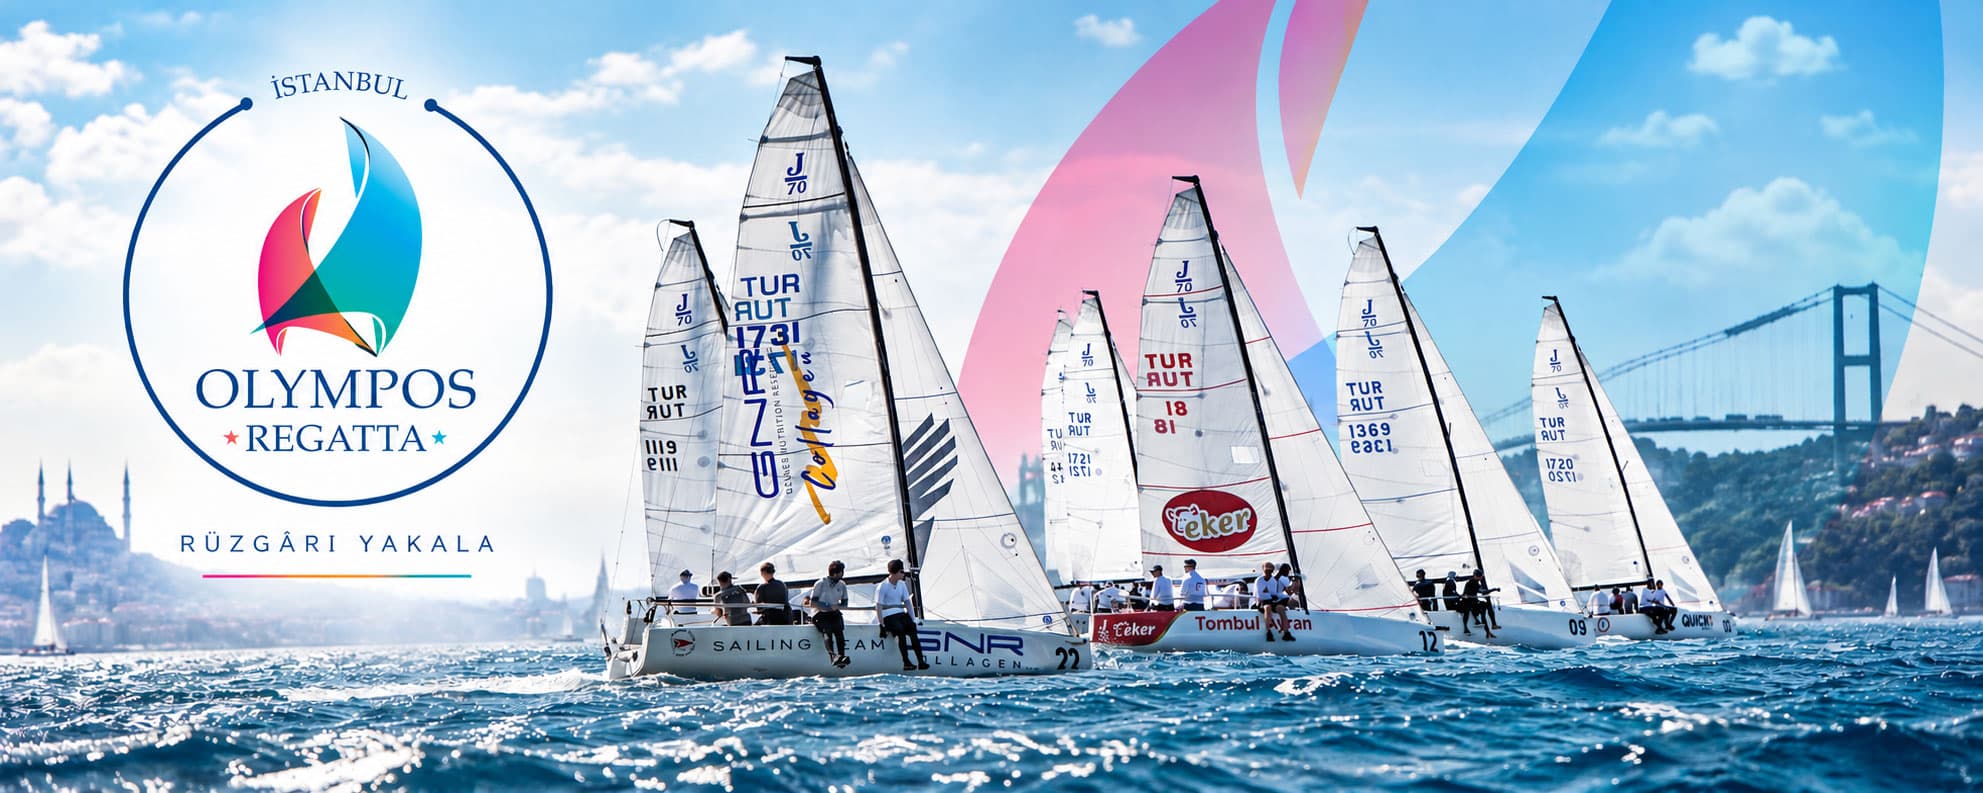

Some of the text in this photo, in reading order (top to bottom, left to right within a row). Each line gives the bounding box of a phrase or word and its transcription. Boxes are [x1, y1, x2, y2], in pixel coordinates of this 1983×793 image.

[787, 152, 805, 177] J
[787, 180, 807, 195] 70
[1175, 260, 1189, 279] J
[740, 273, 800, 297] TUR
[1176, 282, 1193, 292] 70
[677, 294, 688, 311] J
[1361, 299, 1373, 315] J
[678, 315, 692, 326] 70
[1362, 318, 1377, 327] 70
[736, 320, 800, 348] 1731
[1083, 359, 1094, 367] 70
[1144, 353, 1193, 369] TUR
[1551, 365, 1562, 373] 70
[648, 385, 687, 402] TUR
[1346, 381, 1383, 396] TUR
[1165, 401, 1188, 416] 18
[795, 351, 836, 490] Collagen
[1068, 412, 1092, 424] TUR
[1539, 417, 1565, 429] TUR
[1047, 428, 1063, 439] TU
[1349, 422, 1391, 438] 1369
[1068, 453, 1091, 464] 1721
[1545, 458, 1574, 470] 1720
[1185, 510, 1249, 538] eker
[1195, 616, 1260, 631] Tombul
[1569, 618, 1587, 636] 09
[713, 638, 885, 652] SAILING EAM
[1419, 630, 1439, 652] 12
[1055, 646, 1081, 671] 22
